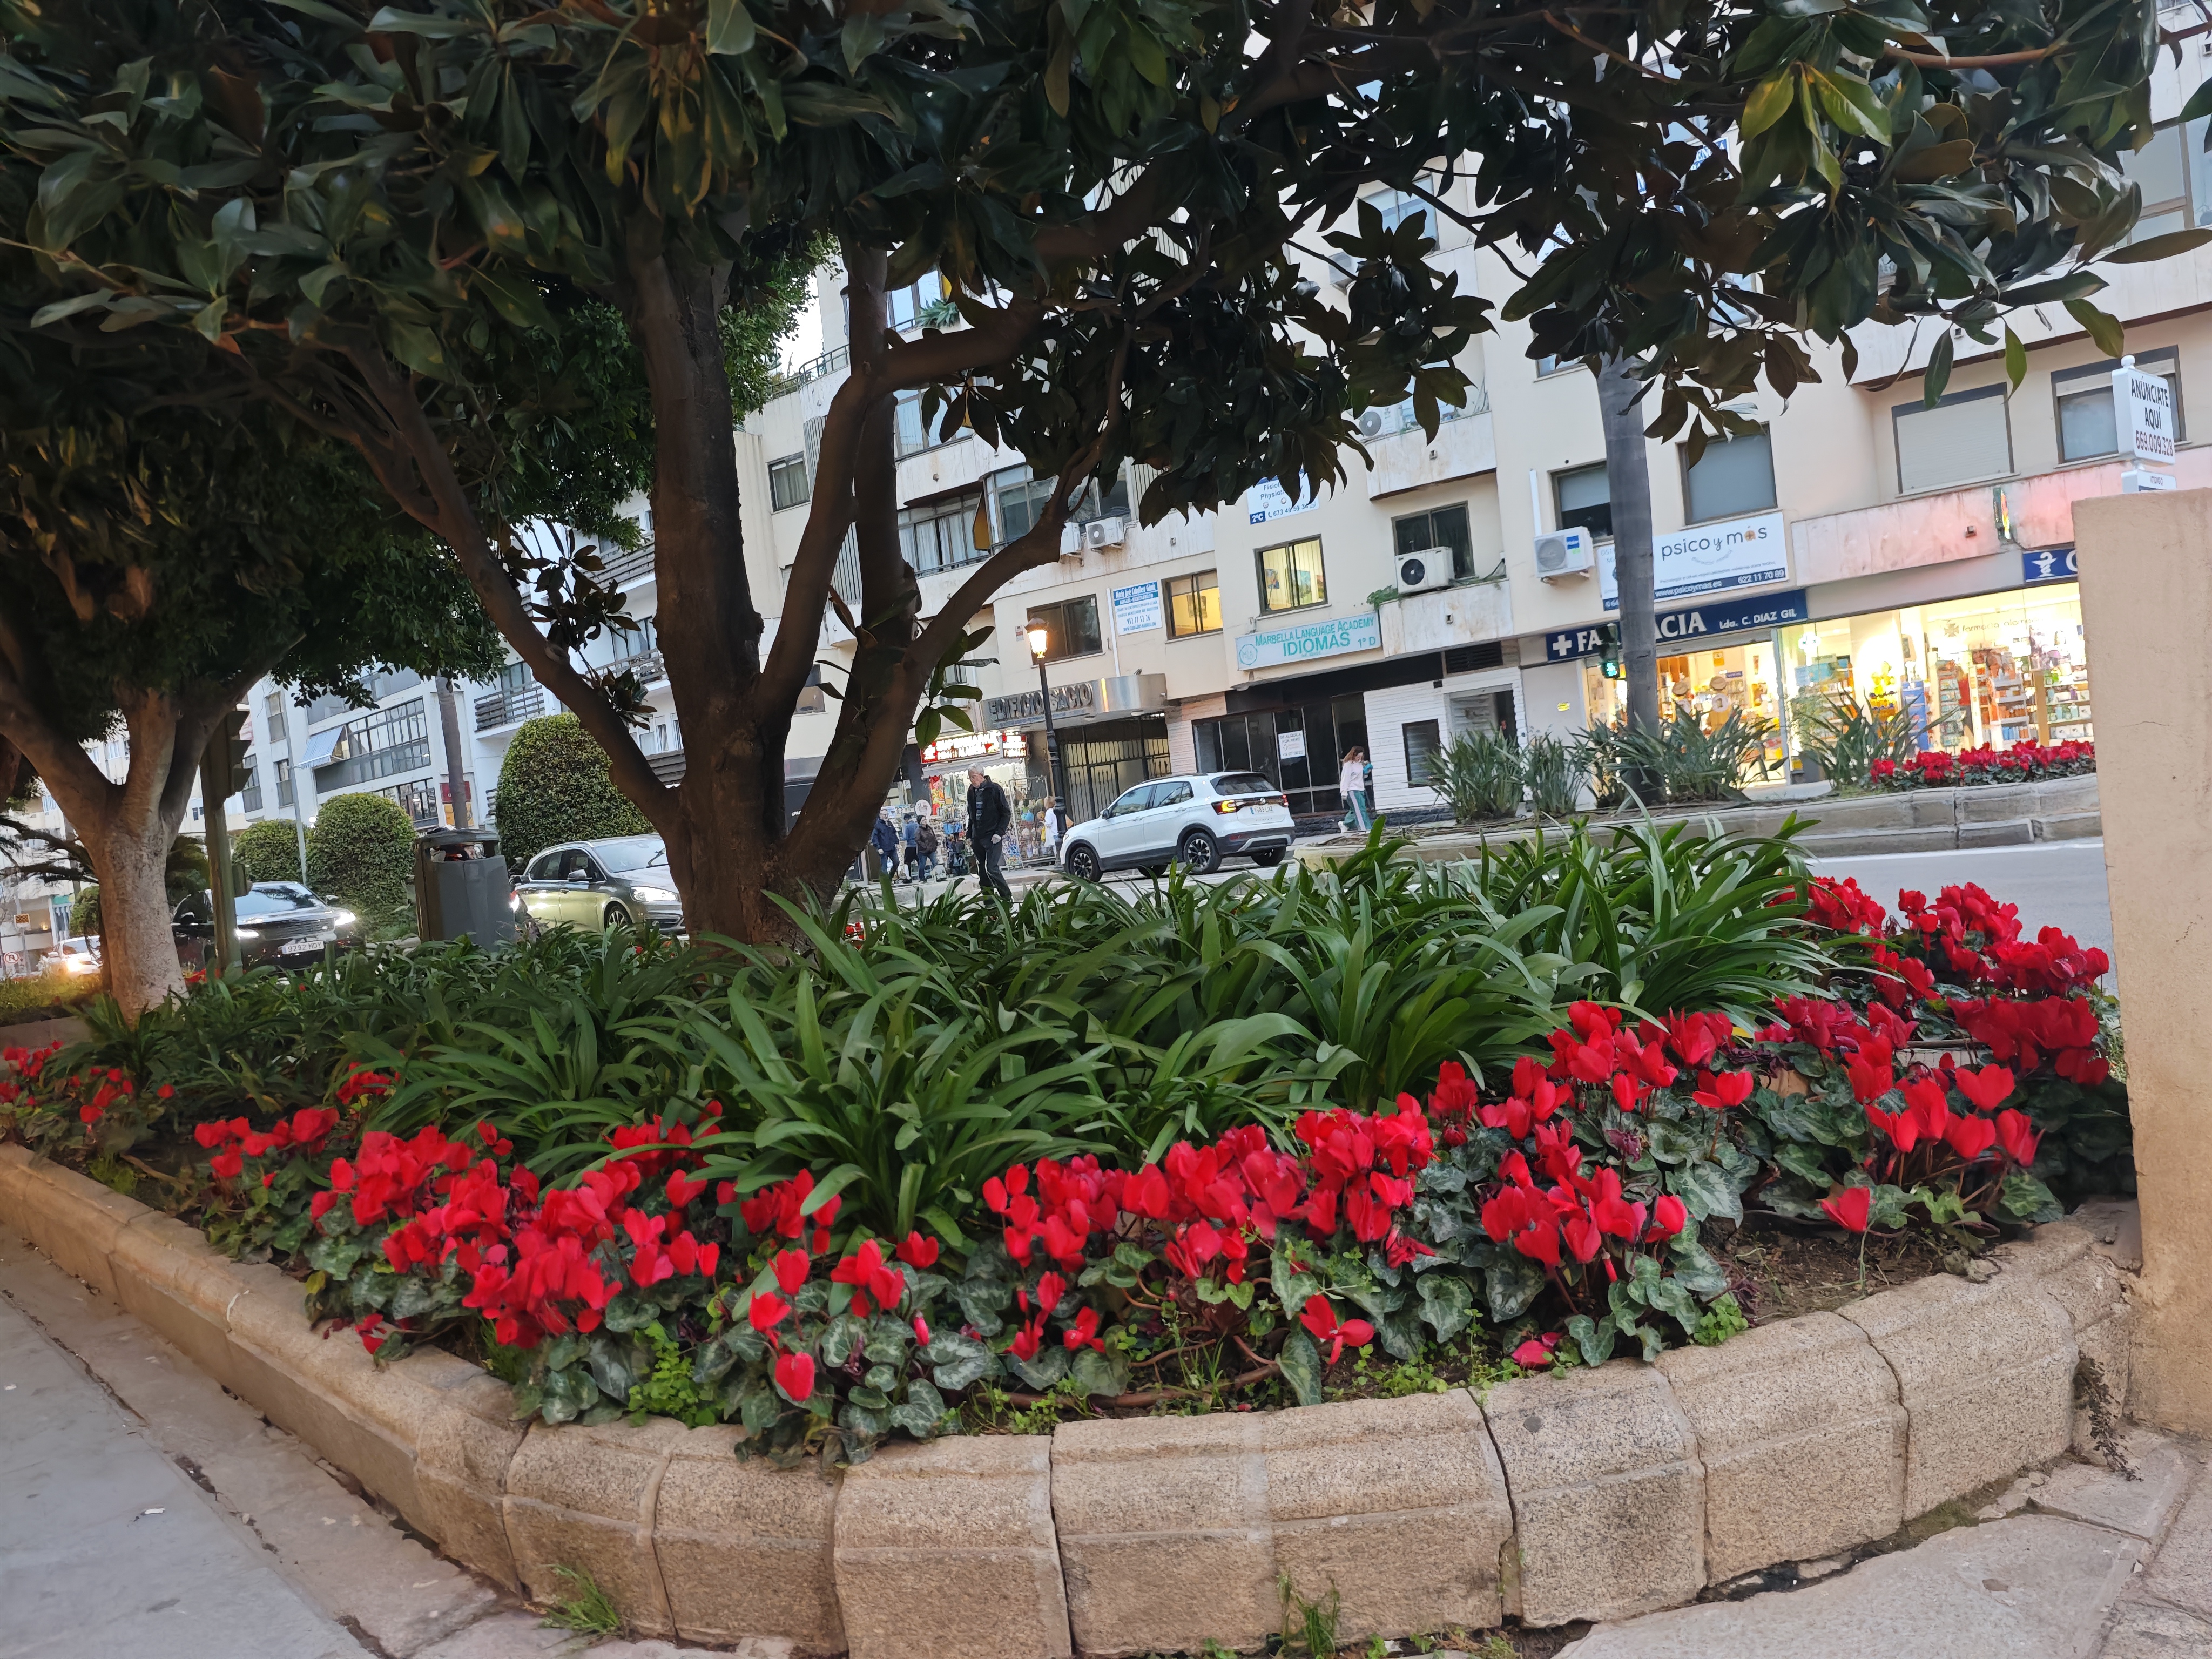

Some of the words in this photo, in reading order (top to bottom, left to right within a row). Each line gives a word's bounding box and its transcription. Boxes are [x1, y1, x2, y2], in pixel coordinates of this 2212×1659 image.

[2131, 376, 2169, 408] ANÚNCIATE
[2144, 407, 2162, 430] AQUÍ
[2136, 430, 2173, 457] 669.009.328
[1260, 491, 1285, 500] Physiot
[1661, 538, 1710, 561] psico
[1713, 537, 1723, 551] y
[1727, 525, 1768, 545] más
[1655, 581, 1723, 598] www.psicoymas.es
[1737, 576, 1752, 584] 622
[1255, 631, 1294, 646] MARBELLA
[1296, 624, 1335, 639] LANGUAGE
[1338, 617, 1374, 631] ACADEMY
[1577, 611, 1707, 652] FACIA
[1742, 616, 1751, 625] C.
[1754, 611, 1778, 624] DIAZ
[1781, 608, 1797, 618] GIL
[1283, 632, 1351, 657] IDIOMAS
